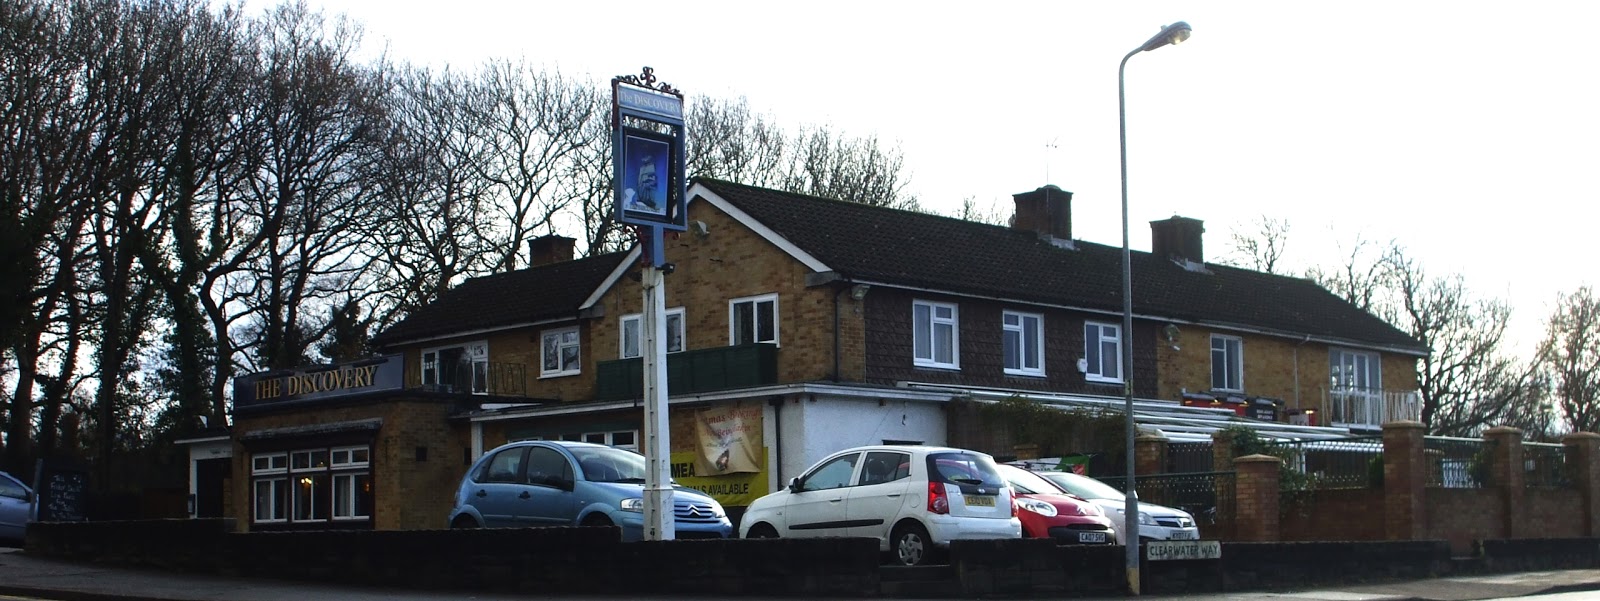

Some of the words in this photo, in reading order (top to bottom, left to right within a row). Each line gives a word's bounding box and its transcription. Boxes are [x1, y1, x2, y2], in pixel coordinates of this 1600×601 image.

[620, 91, 632, 102] The
[634, 95, 680, 112] DISCOVERY
[254, 379, 281, 400] THE
[287, 366, 377, 396] DISCOVERY
[708, 483, 749, 495] AVAILABLE
[1149, 544, 1199, 556] CLEARWATER
[1200, 544, 1218, 556] WAY
